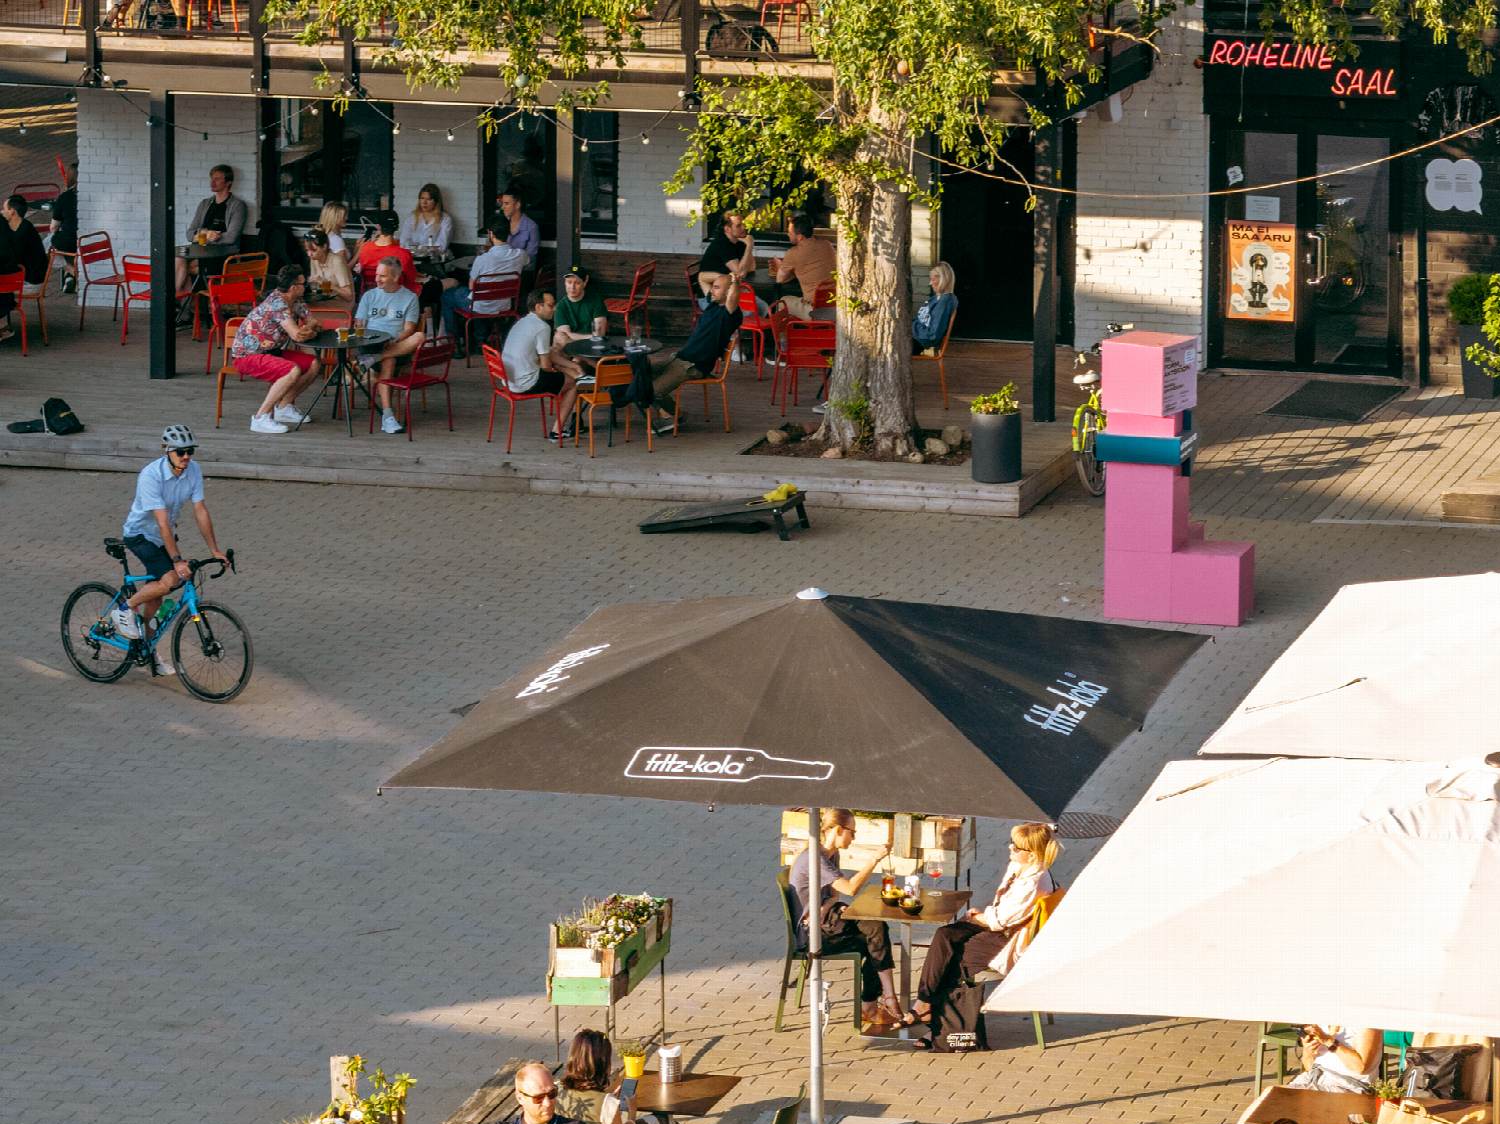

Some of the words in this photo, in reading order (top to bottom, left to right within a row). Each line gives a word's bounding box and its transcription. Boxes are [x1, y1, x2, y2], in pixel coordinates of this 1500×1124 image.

[1210, 40, 1334, 70] ROHELINE
[1331, 68, 1397, 95] SAAL
[1232, 223, 1254, 233] MA
[1257, 225, 1269, 234] EI
[1231, 232, 1261, 242] SAA
[1262, 233, 1292, 243] ARU
[371, 307, 403, 319] BOS
[644, 753, 745, 775] fritz-kola
